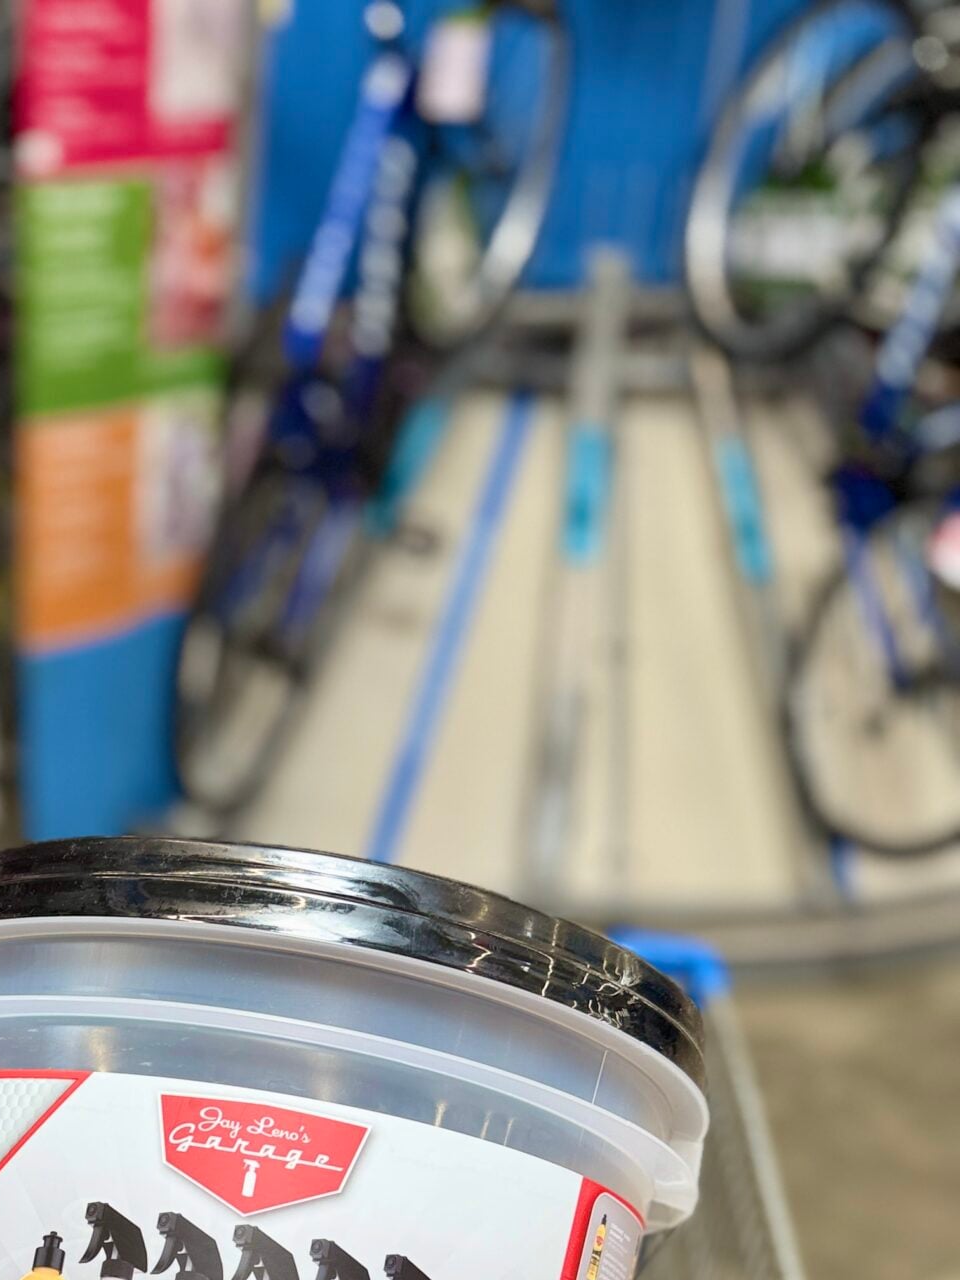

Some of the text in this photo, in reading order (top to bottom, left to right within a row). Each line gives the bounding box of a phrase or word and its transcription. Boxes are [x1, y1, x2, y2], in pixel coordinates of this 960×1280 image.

[168, 1122, 345, 1172] Garage
[198, 1106, 312, 1144] Jay Leno's
